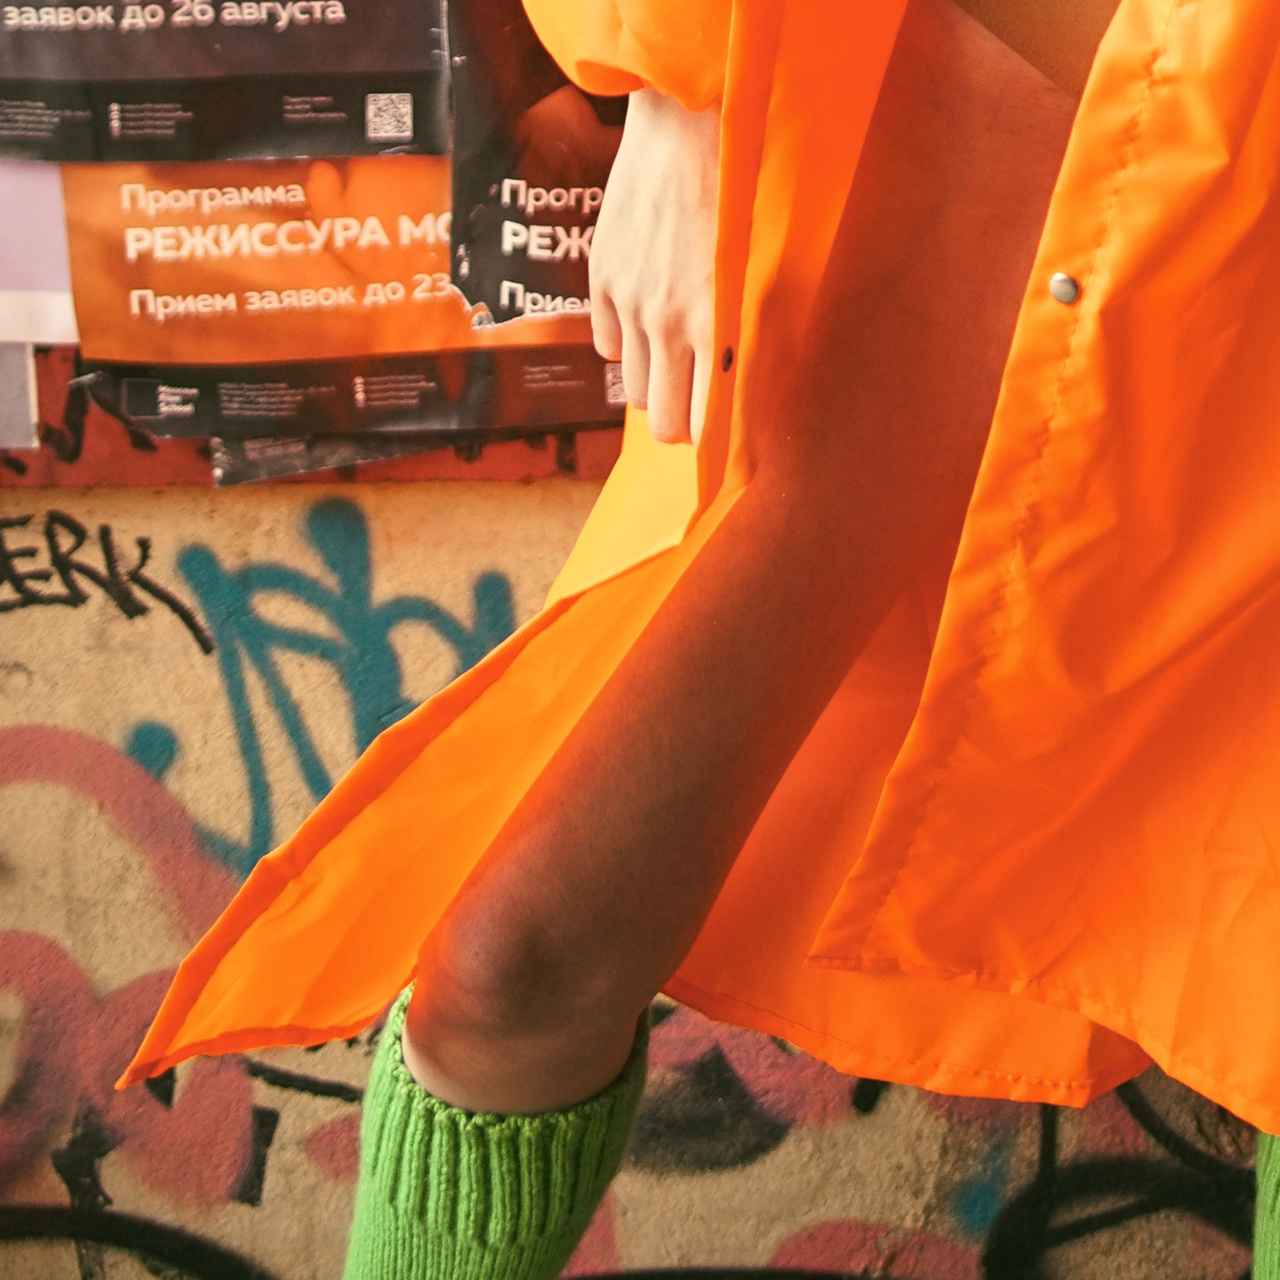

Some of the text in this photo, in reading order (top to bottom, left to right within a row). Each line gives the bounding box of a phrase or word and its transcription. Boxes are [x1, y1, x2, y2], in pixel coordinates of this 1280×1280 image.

[4, 3, 114, 31] заявок
[120, 2, 165, 33] до
[120, 182, 306, 216] Программа
[125, 216, 391, 263] РЕЖИССУРА
[129, 272, 453, 324] Прием заявок до 23
